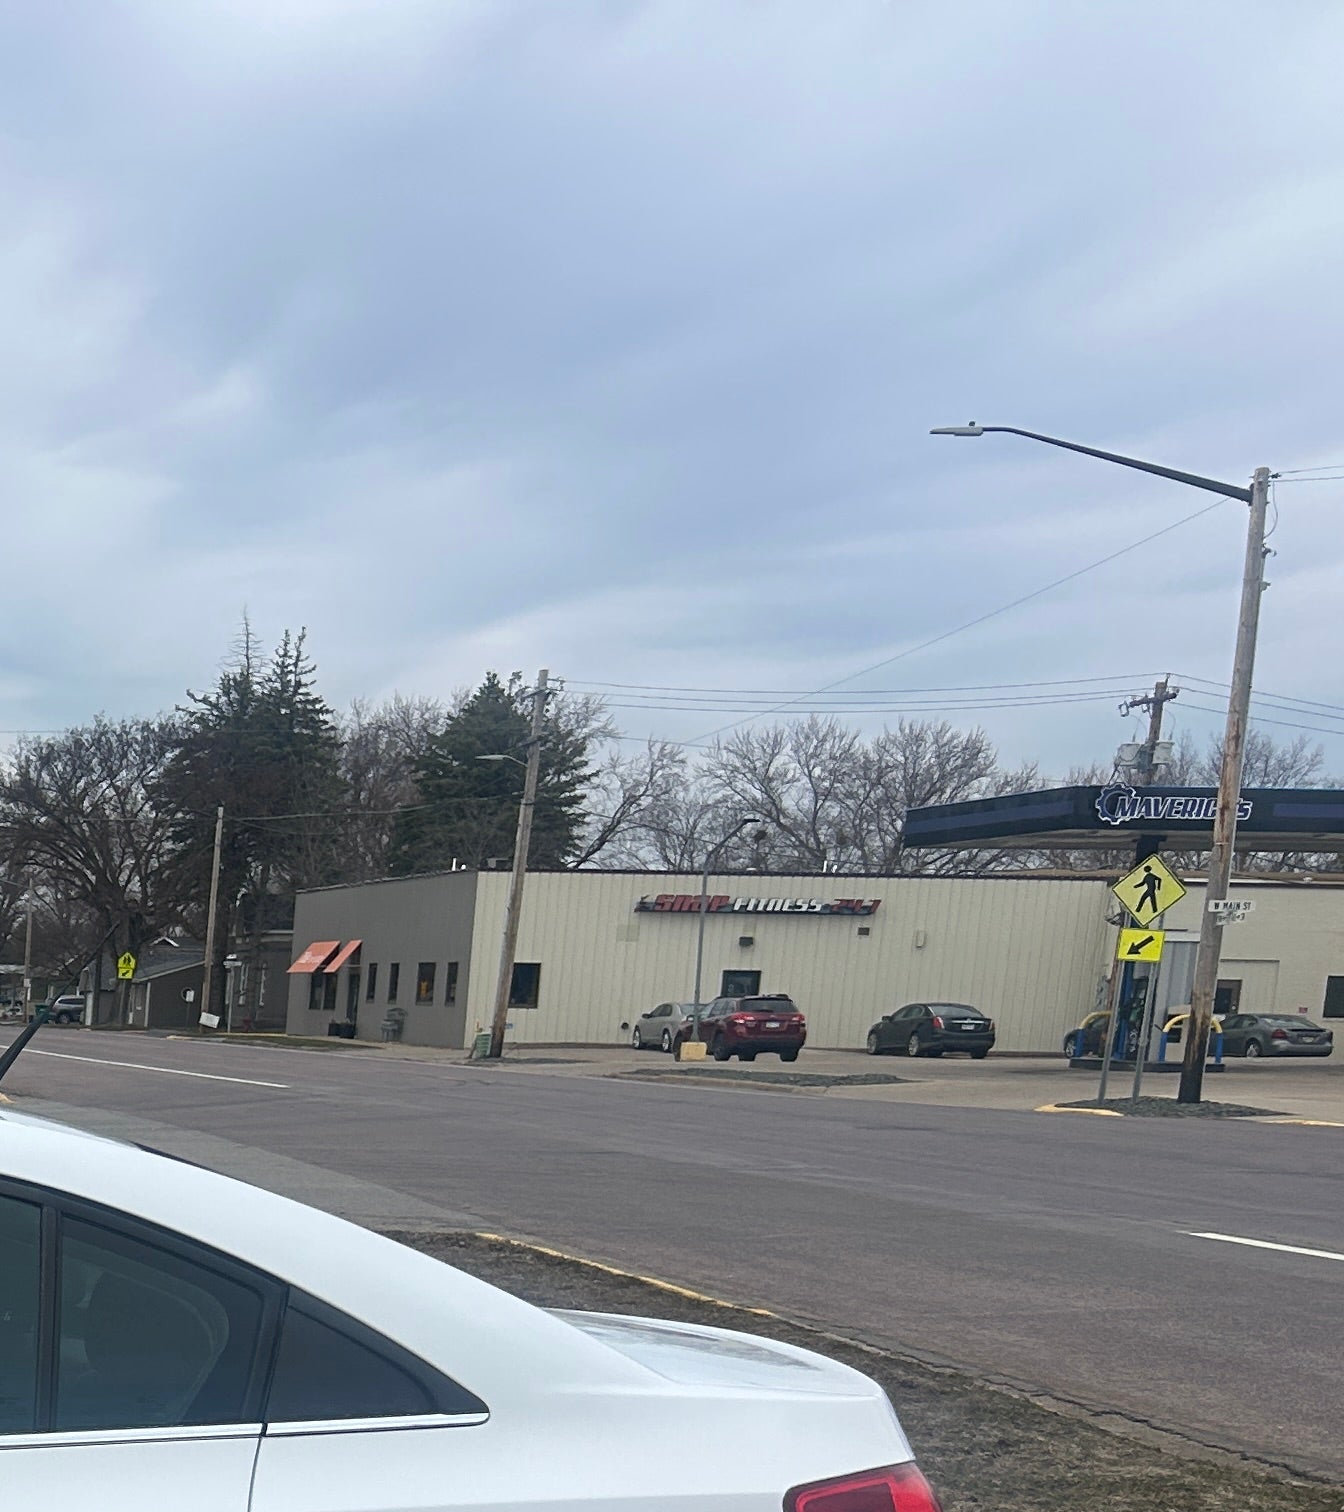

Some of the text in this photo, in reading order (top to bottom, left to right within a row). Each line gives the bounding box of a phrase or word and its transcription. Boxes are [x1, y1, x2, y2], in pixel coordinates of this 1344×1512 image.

[1115, 797, 1253, 820] MAVERICS
[1223, 901, 1241, 910] MAIN
[1243, 901, 1252, 910] ST
